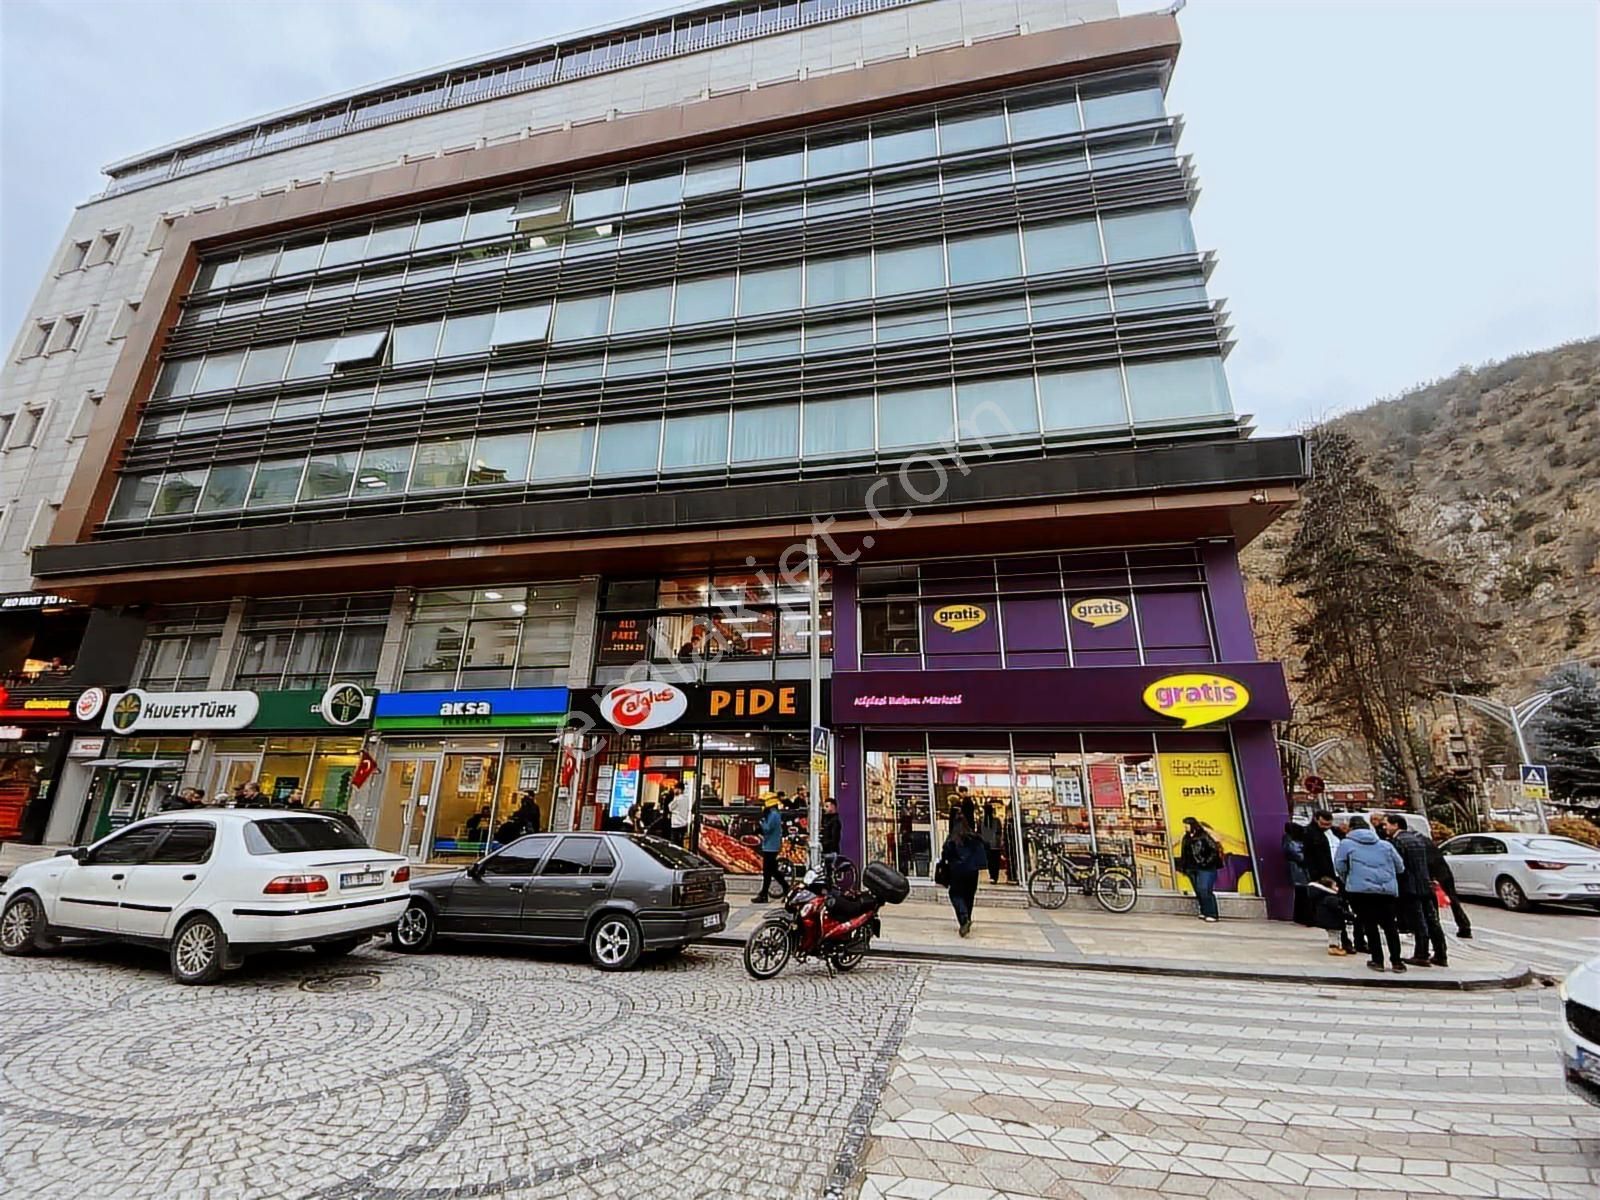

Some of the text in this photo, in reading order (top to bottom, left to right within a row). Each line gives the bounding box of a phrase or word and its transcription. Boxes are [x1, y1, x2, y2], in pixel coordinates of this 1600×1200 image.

[939, 606, 980, 622] gratis
[1077, 601, 1122, 618] gratis
[1155, 680, 1237, 708] gratis
[440, 701, 491, 716] aksa
[1182, 784, 1215, 797] gratis
